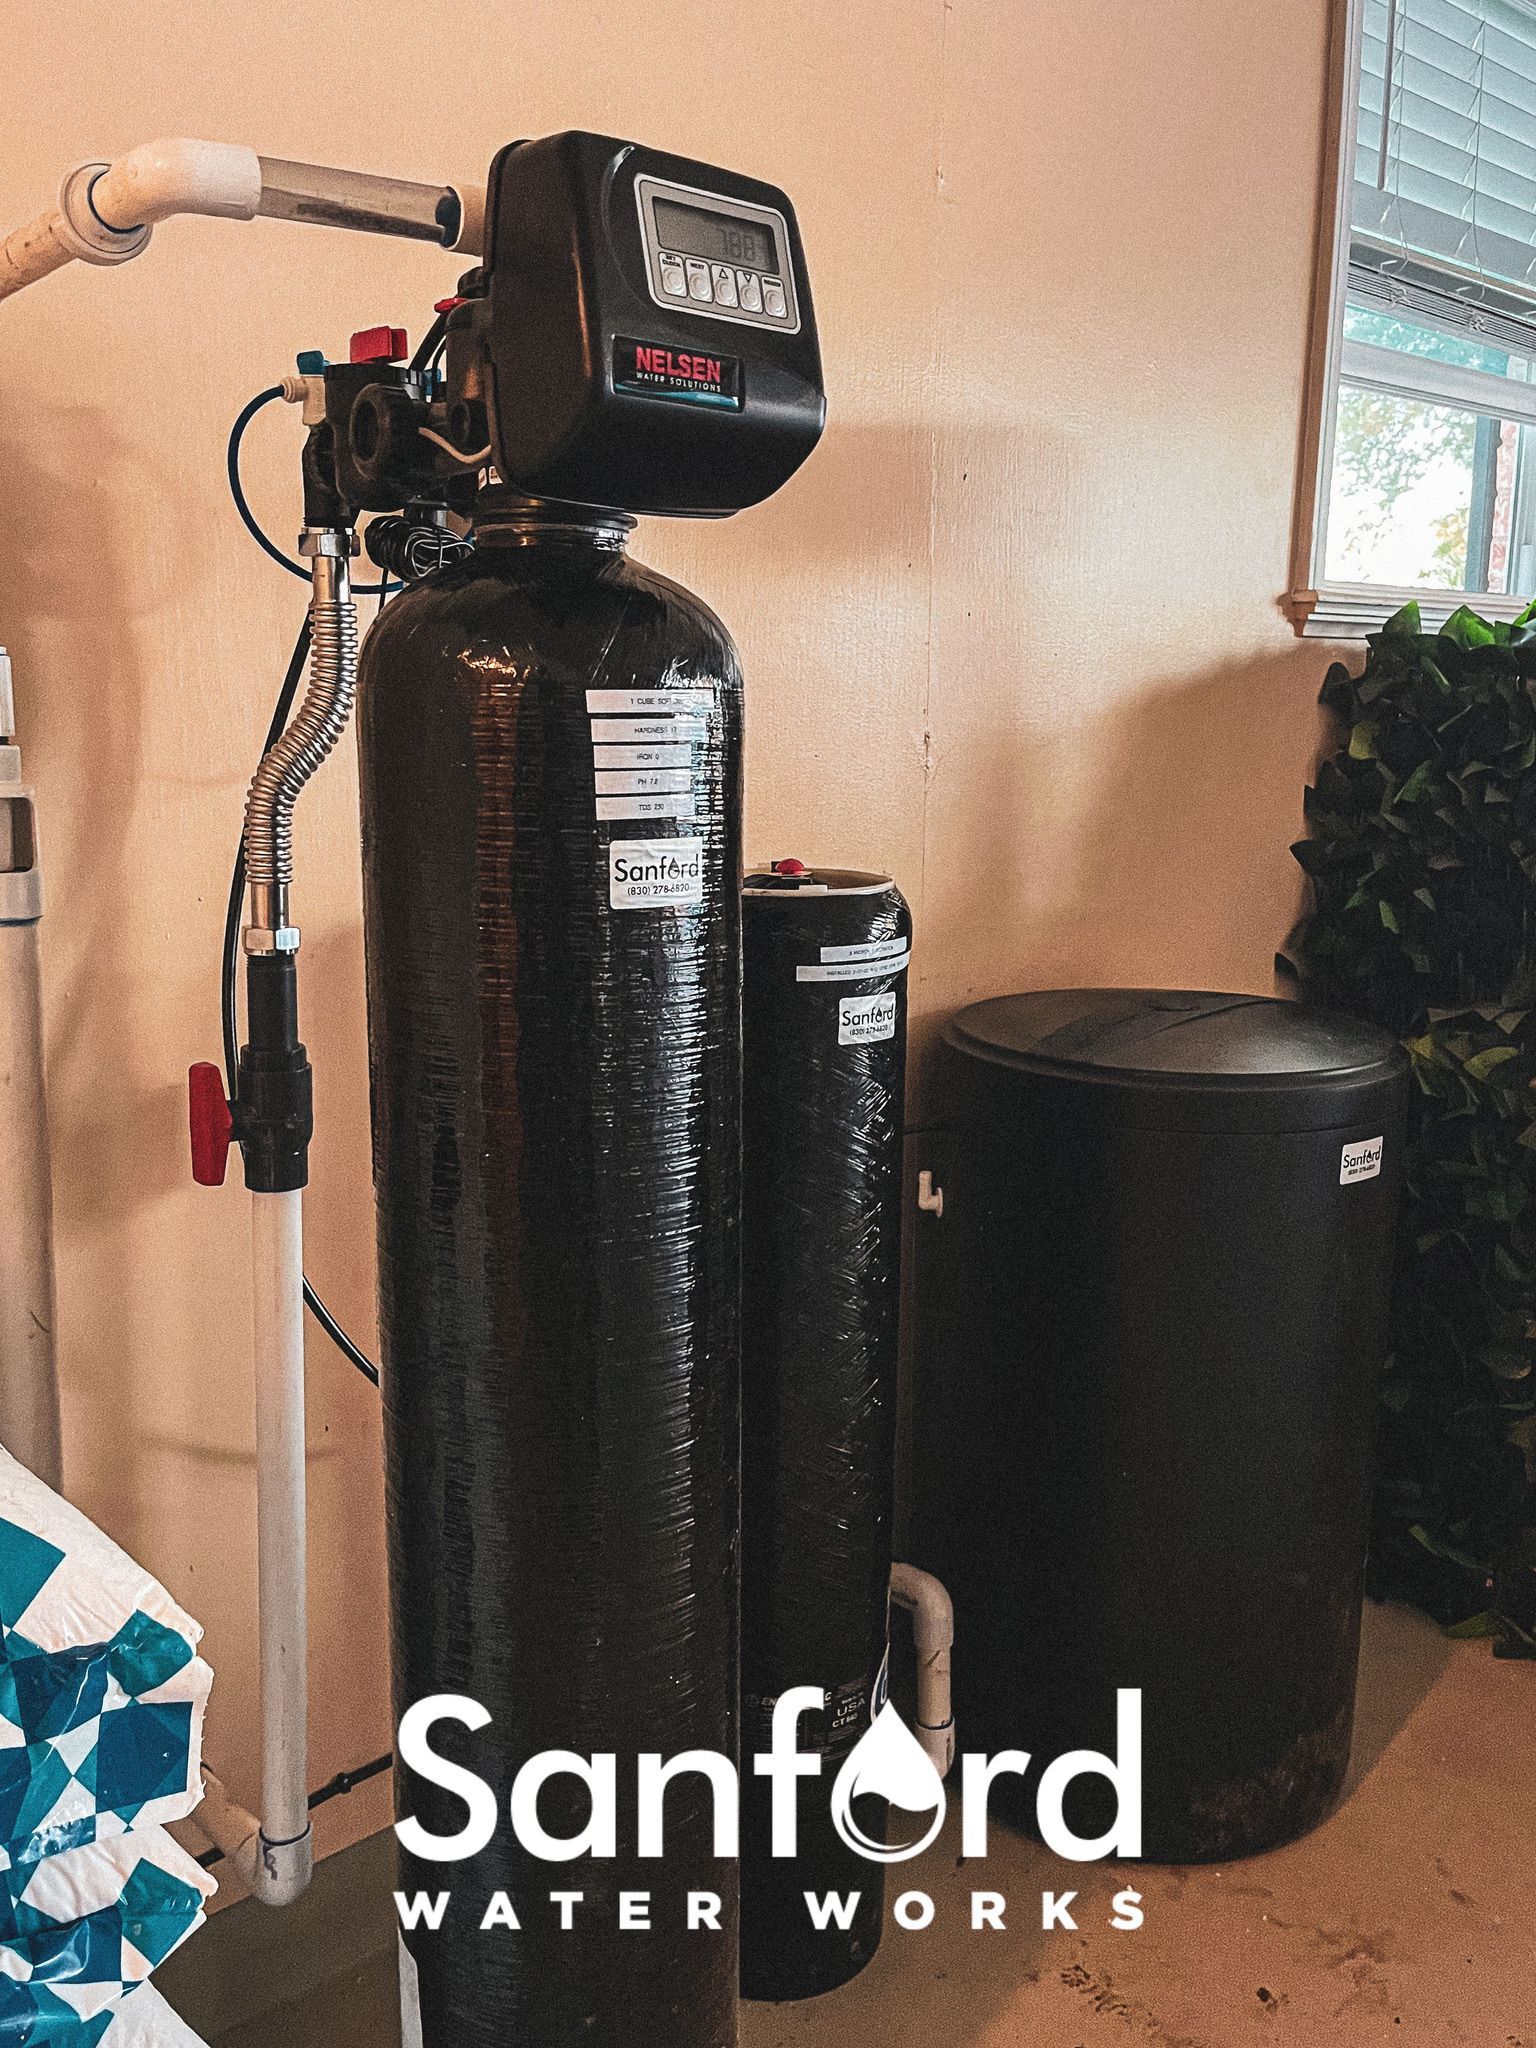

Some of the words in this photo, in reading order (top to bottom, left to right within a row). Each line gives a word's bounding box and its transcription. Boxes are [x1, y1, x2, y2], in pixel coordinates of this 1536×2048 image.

[636, 346, 720, 383] NELSEN
[636, 372, 665, 382] WATER
[670, 377, 721, 392] SOLUTIONS
[614, 853, 699, 883] Sanford
[628, 886, 650, 896] (830)
[653, 883, 690, 895] 278-6820
[842, 1003, 894, 1026] Sanford
[1343, 1145, 1381, 1169] Sanford
[837, 1698, 865, 1717] USA
